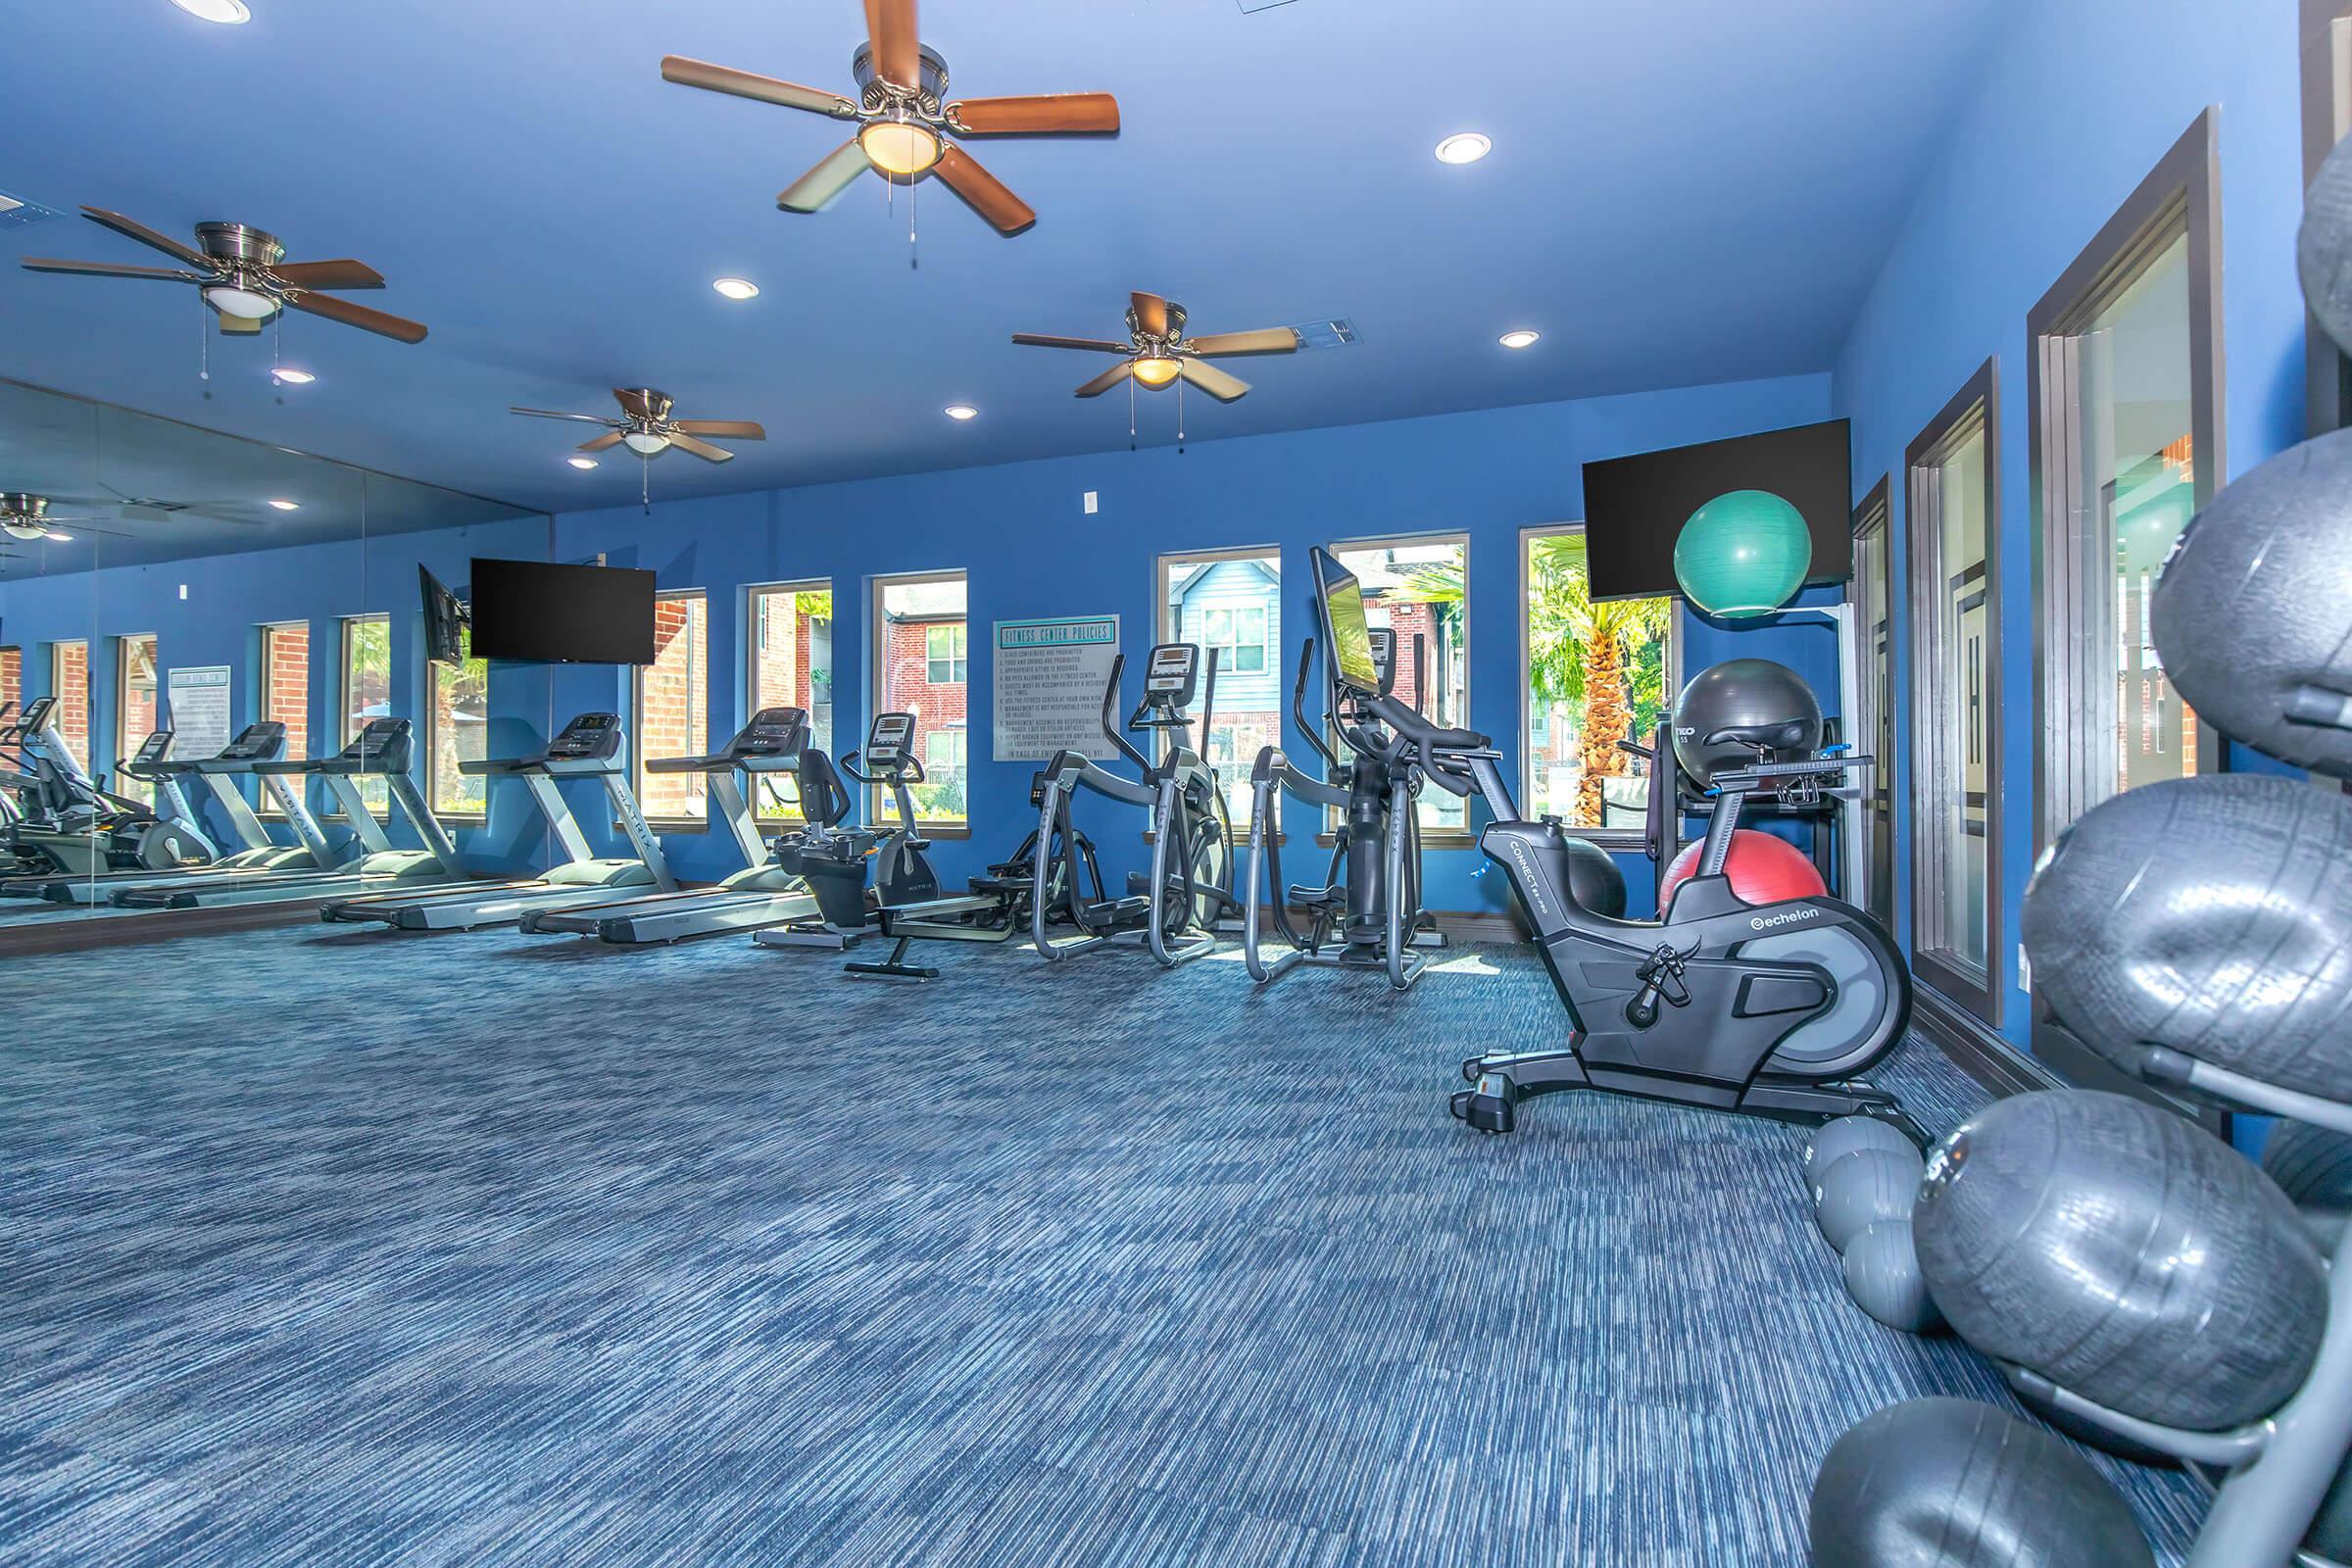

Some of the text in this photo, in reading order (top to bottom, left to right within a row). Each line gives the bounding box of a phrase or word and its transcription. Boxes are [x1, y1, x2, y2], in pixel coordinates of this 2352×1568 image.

[1004, 625, 1107, 643] FITNESS CENTER POLICIES
[617, 787, 652, 850] MATRIX
[1392, 808, 1402, 852] MATRIX
[1509, 841, 1539, 888] CONNECT
[1764, 908, 1820, 927] echelon
